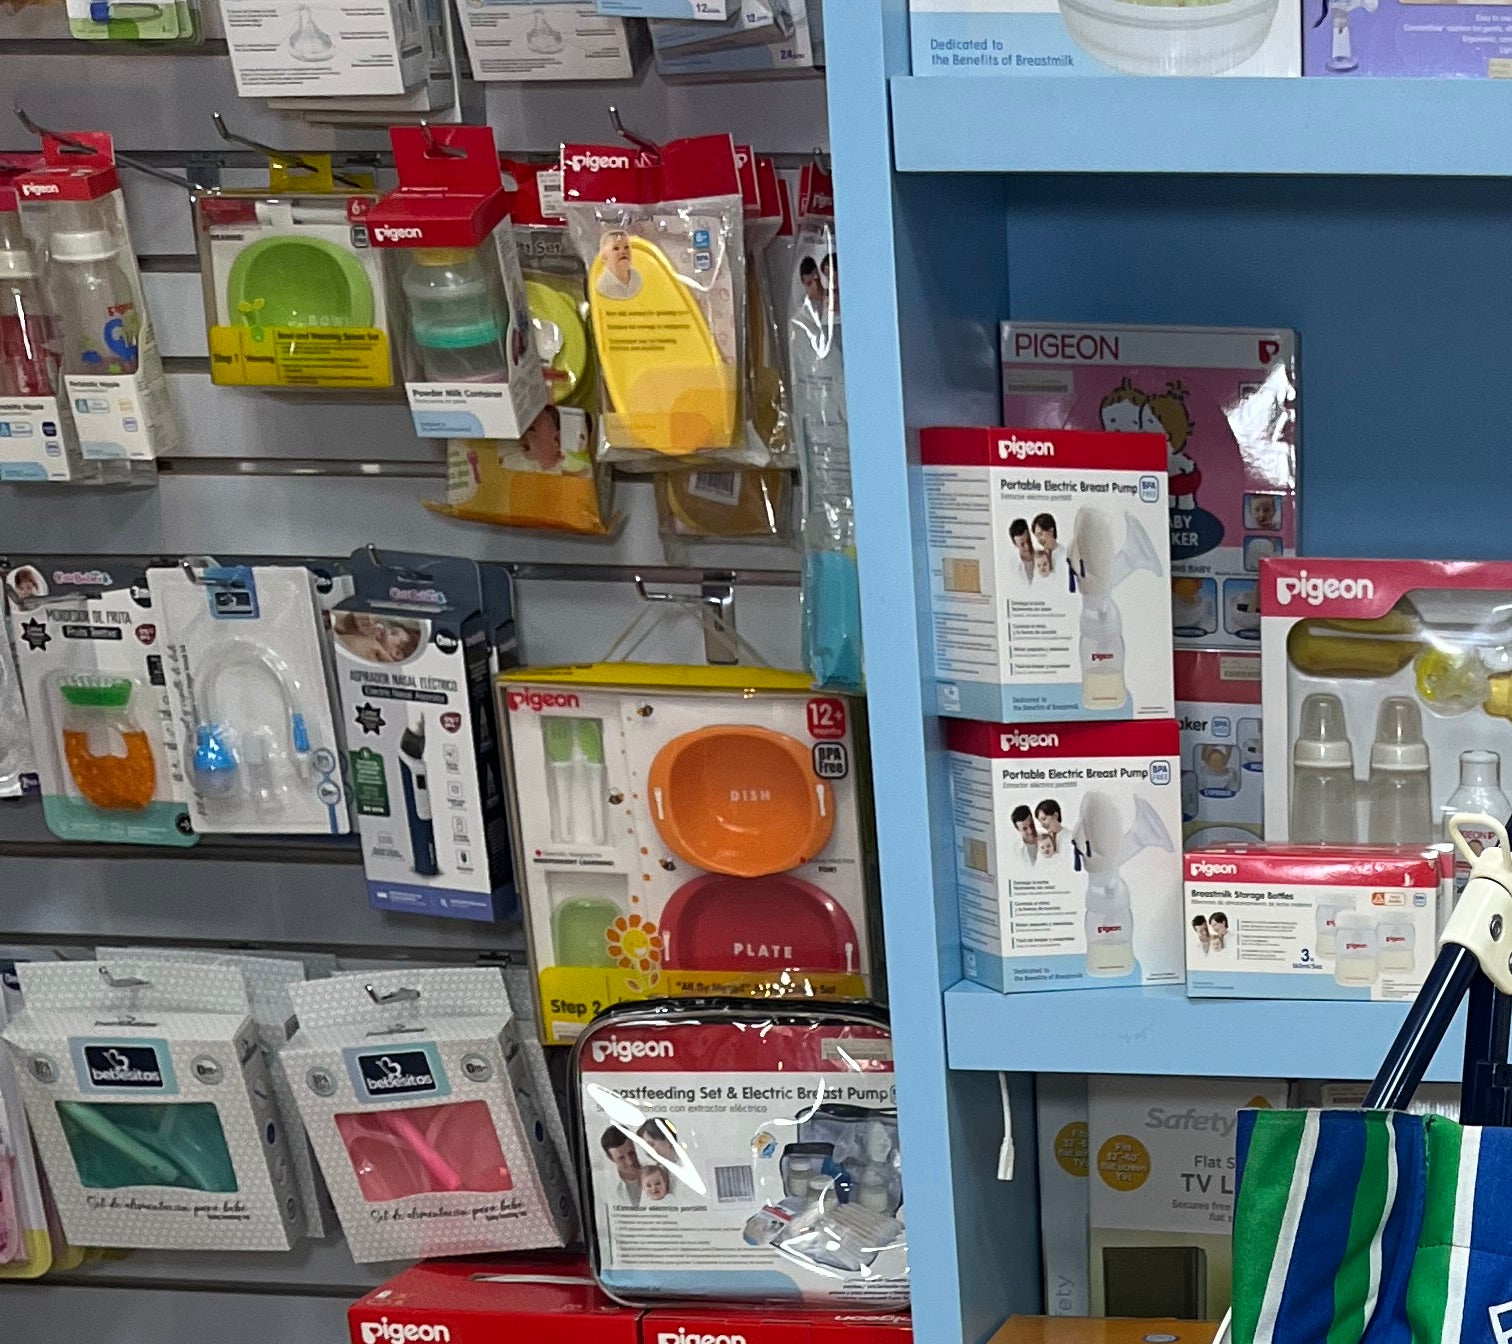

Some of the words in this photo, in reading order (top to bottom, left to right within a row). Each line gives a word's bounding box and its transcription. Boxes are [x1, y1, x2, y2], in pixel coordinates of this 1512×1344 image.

[930, 38, 988, 51] Dedicated
[992, 40, 1004, 51] to
[931, 55, 950, 66] the
[952, 54, 999, 66] Benefits
[1001, 55, 1013, 66] of
[1015, 55, 1074, 67] Breastmilk
[571, 151, 630, 172] pigeon
[374, 224, 423, 242] pigeon
[1014, 333, 1120, 361] PIGEON
[412, 388, 444, 399] Powder
[445, 388, 463, 400] Milk
[464, 389, 503, 400] Container
[997, 434, 1055, 460] pigeon
[1000, 478, 1042, 492] Portable
[1044, 479, 1078, 492] Electric
[1080, 480, 1109, 493] Breast
[1112, 482, 1138, 496] Pump
[1170, 515, 1191, 529] ABY
[1171, 532, 1198, 546] KER
[1276, 569, 1375, 605] pigeon
[507, 688, 580, 712] pigeon
[810, 702, 844, 727] 12+
[1000, 729, 1059, 752] pigeon
[1002, 768, 1045, 780] Portable
[1048, 768, 1084, 779] Electric
[1086, 768, 1117, 779] Breast
[1120, 767, 1148, 781] Pump
[1152, 765, 1168, 773] BPA
[730, 789, 772, 803] DISH
[1190, 860, 1237, 877] pigeon
[1191, 889, 1232, 899] Breastmilk
[1234, 890, 1265, 902] Storage
[1267, 891, 1294, 900] Bottles
[733, 942, 793, 959] PLATE
[1300, 948, 1310, 962] 3
[551, 1000, 588, 1016] Step
[592, 1002, 601, 1015] 2
[591, 1035, 675, 1063] pigeon
[700, 1086, 722, 1100] Set
[726, 1087, 738, 1100] &
[742, 1086, 793, 1101] Electric
[848, 1087, 889, 1105] Pump
[1144, 1108, 1237, 1137] Safety
[1118, 1163, 1146, 1172] screen
[1194, 1155, 1222, 1169] Flat
[1180, 1173, 1212, 1193] TV
[1171, 1200, 1209, 1210] Secures
